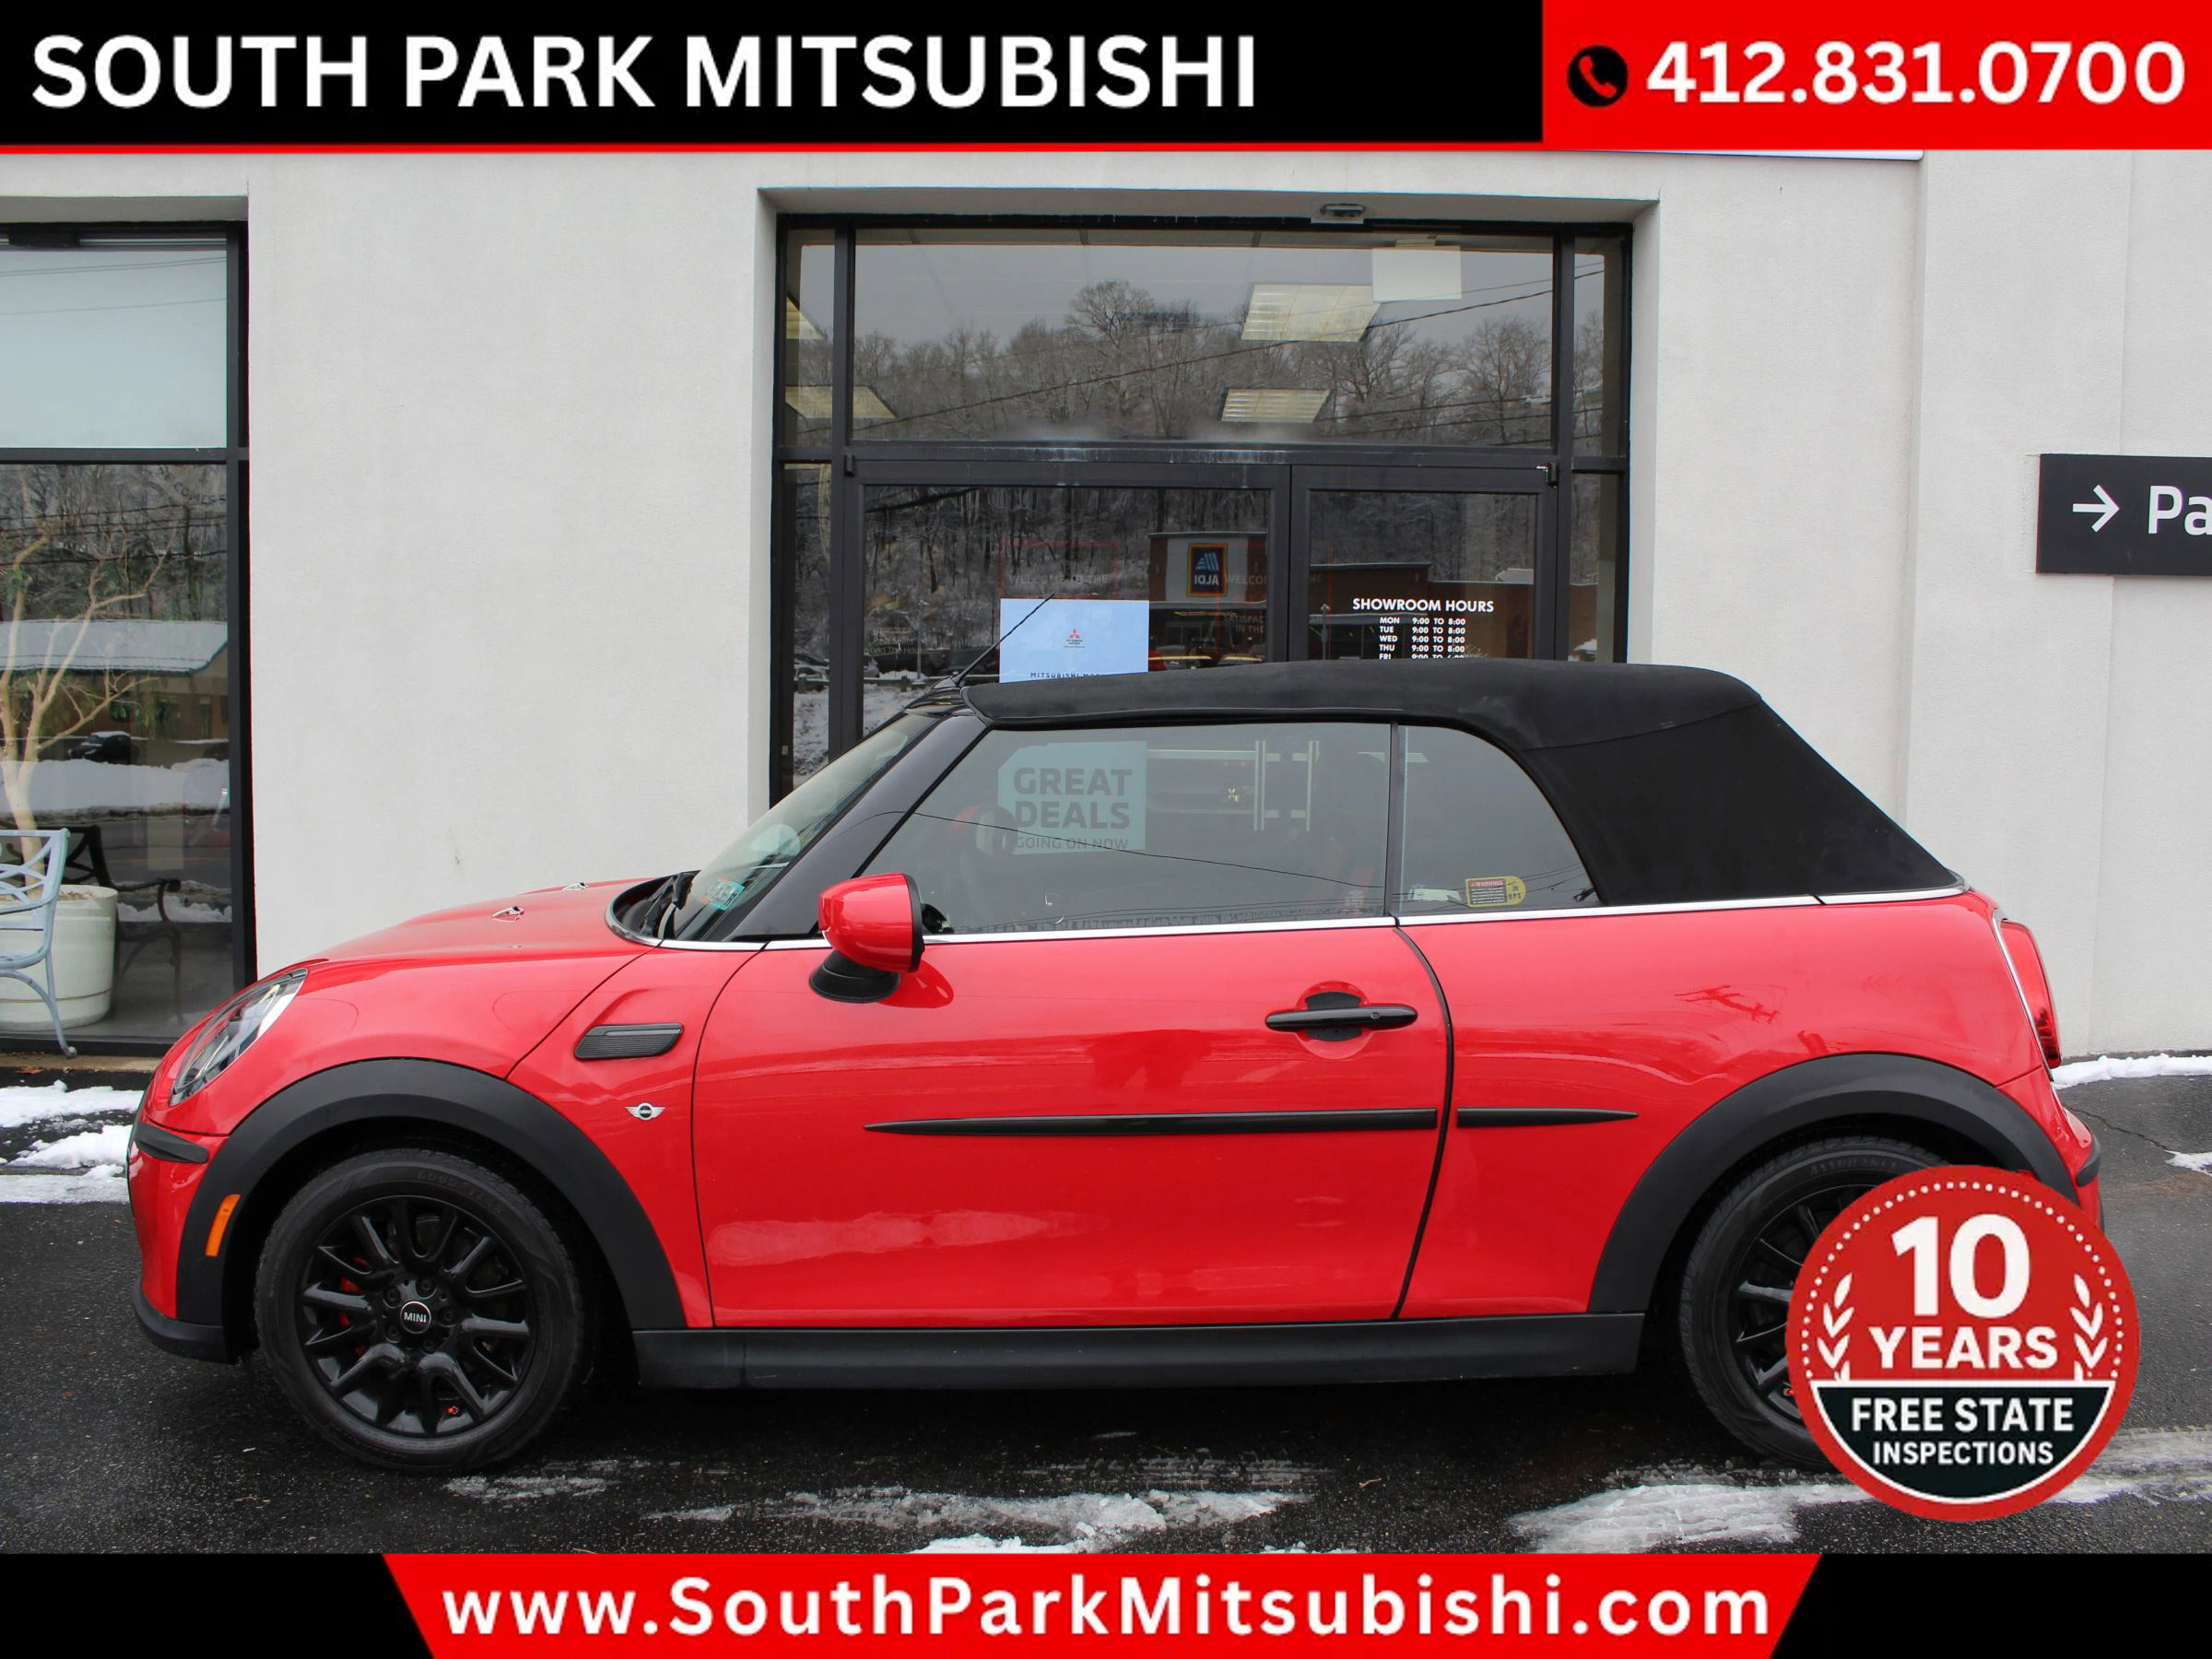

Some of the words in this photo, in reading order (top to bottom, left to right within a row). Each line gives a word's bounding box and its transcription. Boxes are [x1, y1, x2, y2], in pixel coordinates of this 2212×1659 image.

[2147, 486, 2212, 535] Pa
[1352, 598, 1441, 611] SHOWROOM
[1445, 600, 1494, 612] HOURS
[1014, 768, 1133, 795] GREAT
[1015, 801, 1130, 829] DEALS
[1017, 837, 1061, 849] GOING
[1066, 838, 1087, 849] ON
[1092, 838, 1129, 850] NOW
[404, 1312, 427, 1323] MINI
